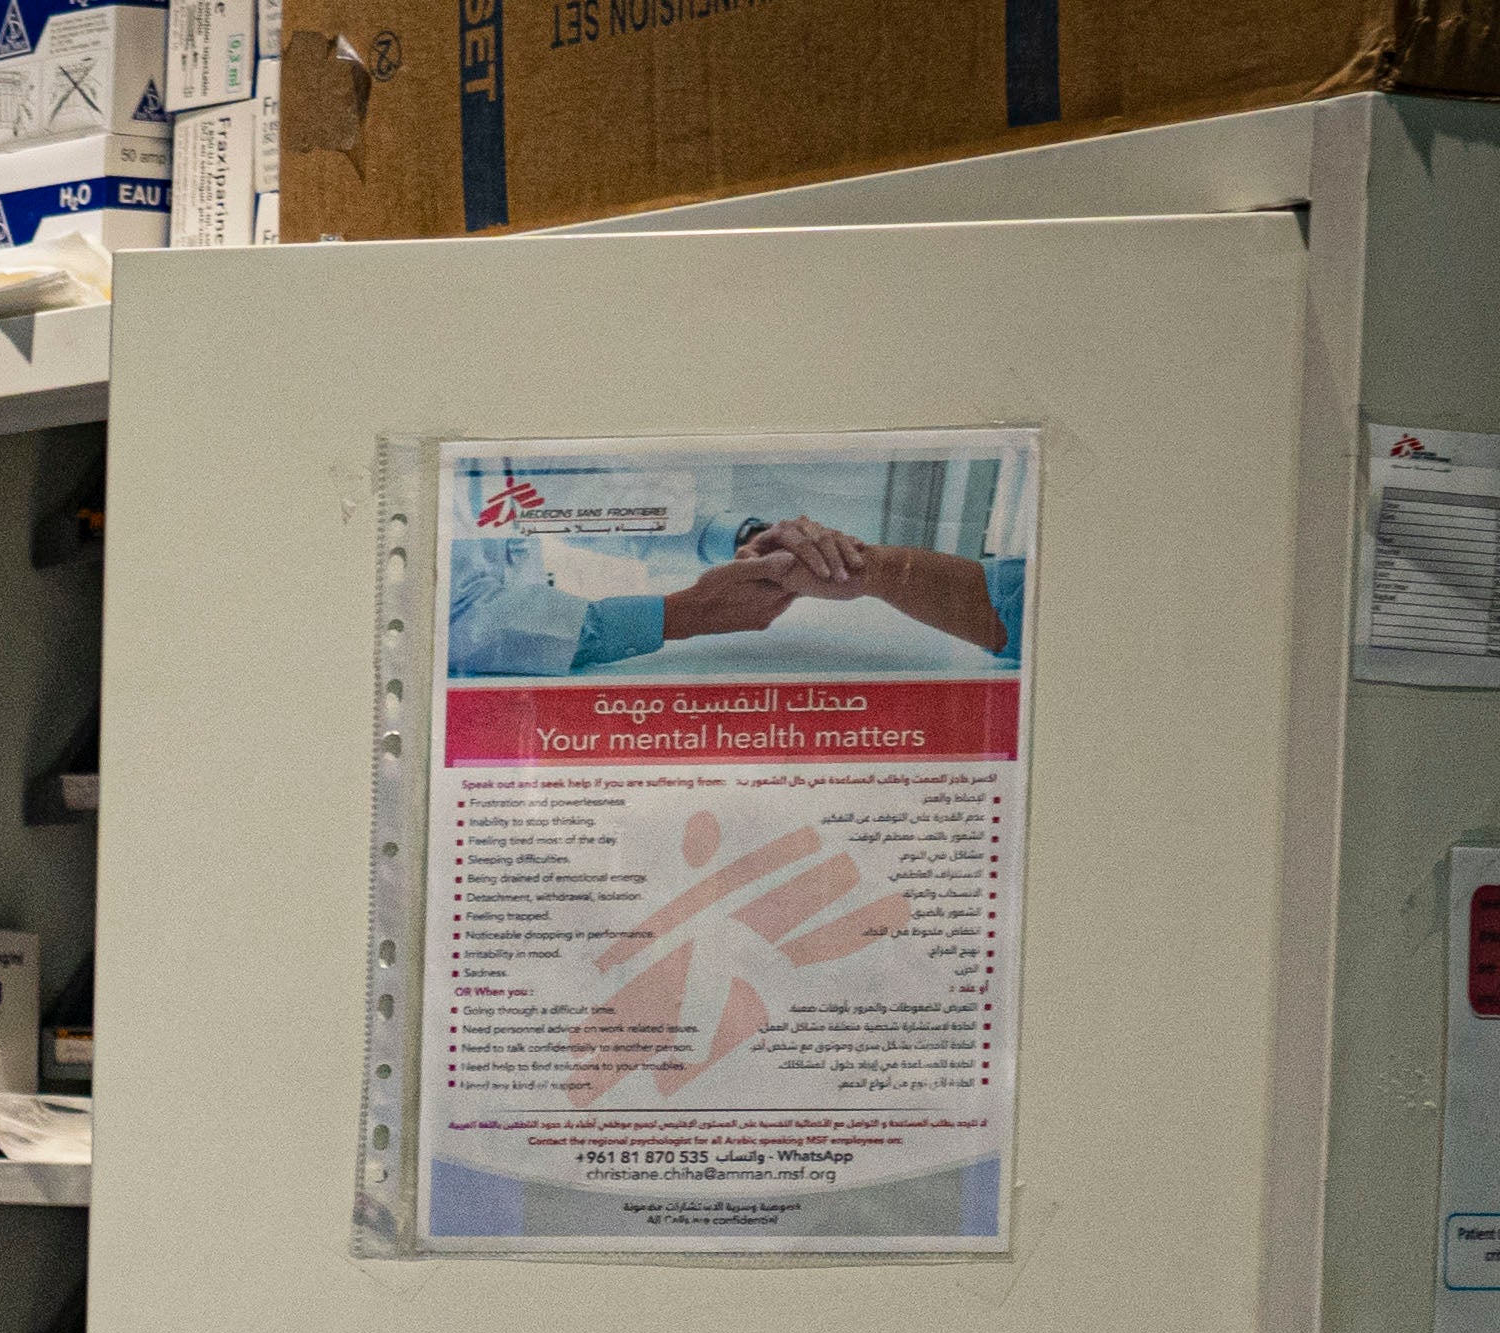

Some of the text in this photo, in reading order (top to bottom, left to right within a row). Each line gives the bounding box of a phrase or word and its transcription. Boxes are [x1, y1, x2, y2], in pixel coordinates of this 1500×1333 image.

[551, 0, 599, 50] SET
[212, 117, 231, 243] Fraxiparine
[118, 184, 161, 206] EAU
[576, 508, 603, 517] SANS
[595, 688, 867, 724] صحتك النفسية مهمة
[536, 723, 925, 751] Your mental health matters
[462, 780, 493, 790] Speak
[498, 780, 515, 789] out
[518, 780, 537, 788] and
[541, 779, 565, 788] seek
[568, 779, 591, 789] help
[595, 778, 602, 787] if
[604, 780, 623, 789] you
[646, 778, 694, 789] suffering
[697, 777, 726, 787] from:
[470, 798, 548, 807] Frustration and
[469, 818, 508, 828] Inability
[512, 818, 523, 827] to
[526, 818, 549, 827] stop
[468, 837, 507, 847] Feeling
[510, 836, 534, 845] tired
[565, 836, 577, 844] of
[579, 835, 595, 844] the
[468, 855, 513, 866] Sleeping
[468, 873, 608, 885] Being drained of emotional
[466, 912, 504, 922] Feeling
[465, 931, 585, 941] Noticeable dropping in
[517, 950, 527, 958] in
[455, 987, 527, 998] OR When you
[463, 1005, 588, 1017] Going through difficult
[463, 1024, 664, 1035] Need personnel advice on work related
[462, 1044, 491, 1052] Need
[493, 1044, 505, 1052] to
[507, 1043, 525, 1052] talk
[610, 1043, 653, 1052] another
[528, 1136, 890, 1148] Contact the regional psychologist for all Arabic speaking MSF employees
[575, 1151, 615, 1164] +961
[620, 1151, 639, 1164] 81
[645, 1151, 675, 1164] 870
[679, 1150, 709, 1163] 535
[778, 1151, 854, 1164] WhatsApp
[586, 1167, 836, 1183] christiane.chiha@amman.msf.org
